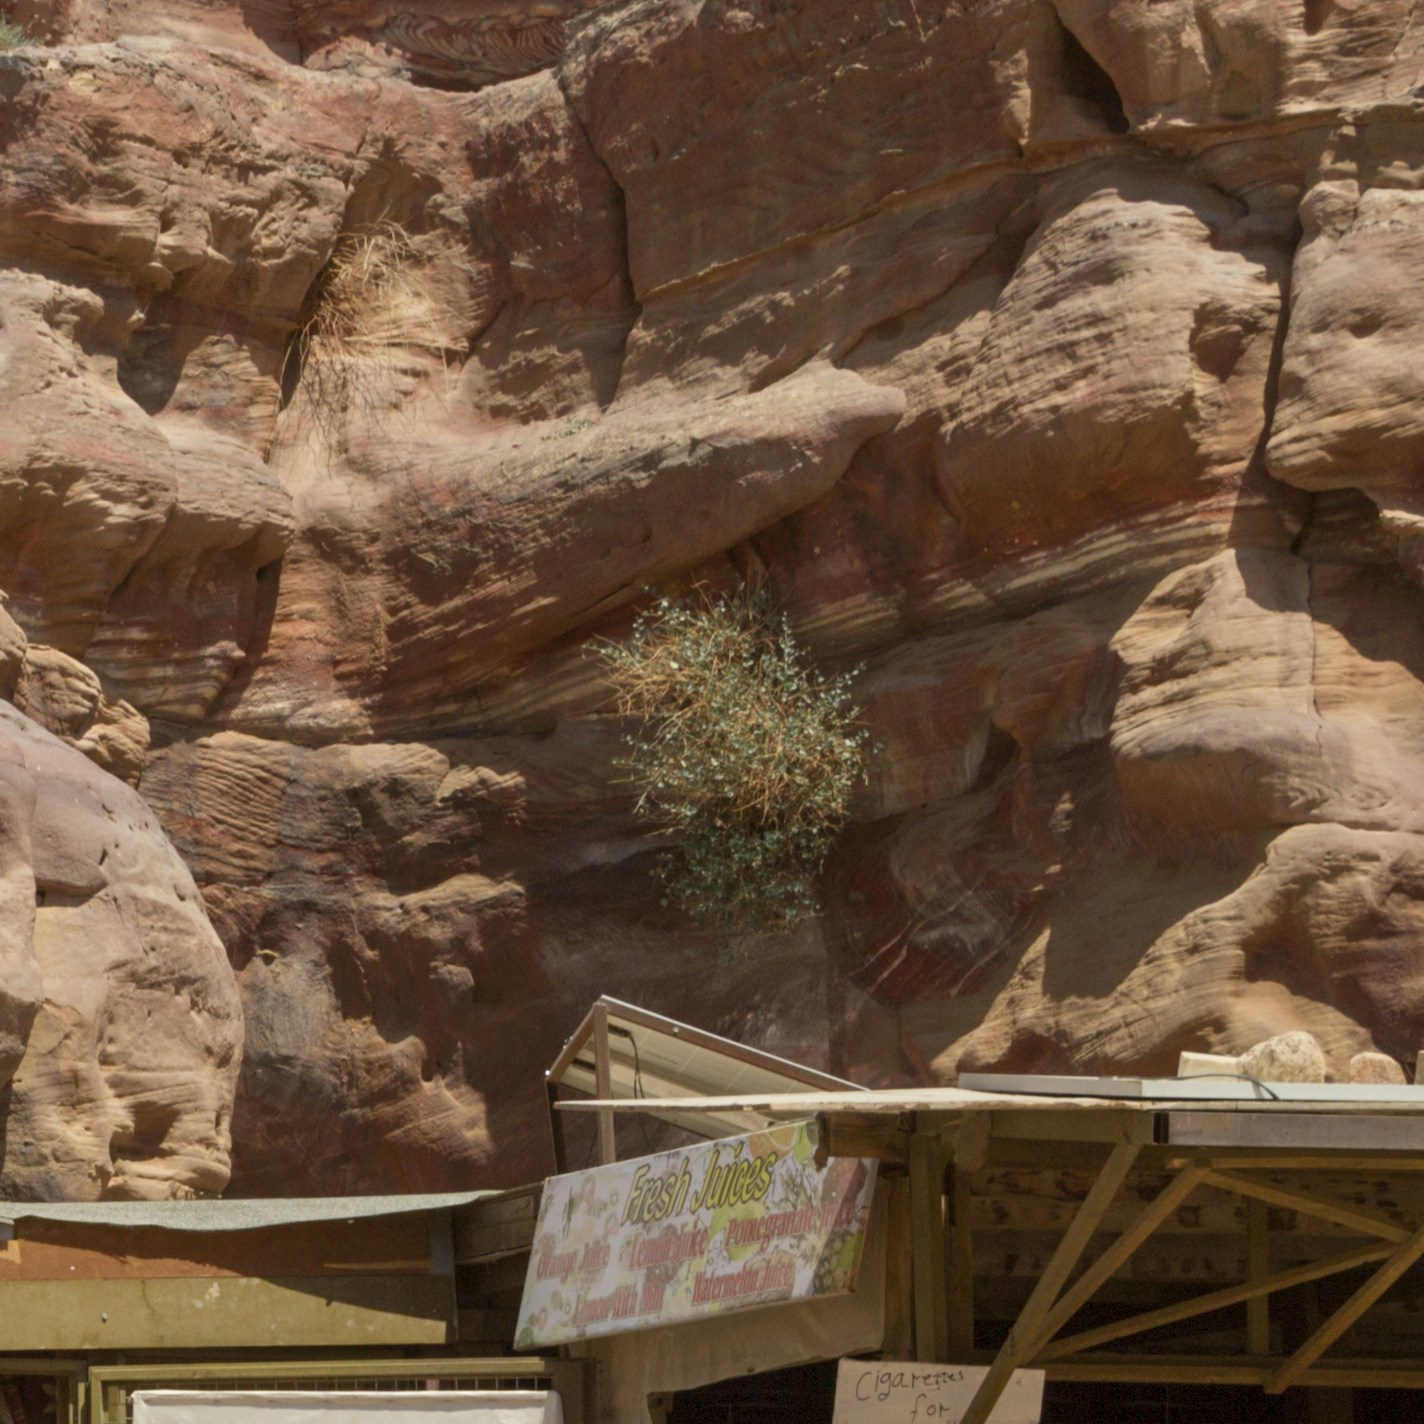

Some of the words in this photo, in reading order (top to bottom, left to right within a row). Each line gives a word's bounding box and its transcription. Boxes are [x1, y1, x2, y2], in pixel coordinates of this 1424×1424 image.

[621, 1157, 692, 1227] Fresh
[690, 1140, 778, 1215] Juices
[628, 1234, 672, 1270] Lemon
[671, 1219, 708, 1260] Juice
[725, 1207, 817, 1252] Pomegranate
[536, 1250, 577, 1284] Orange
[578, 1241, 611, 1274] Juice
[692, 1263, 758, 1306] Watermelon
[758, 1260, 794, 1293] Juice
[855, 1370, 965, 1401] Cigarettes
[911, 1393, 950, 1423] for
